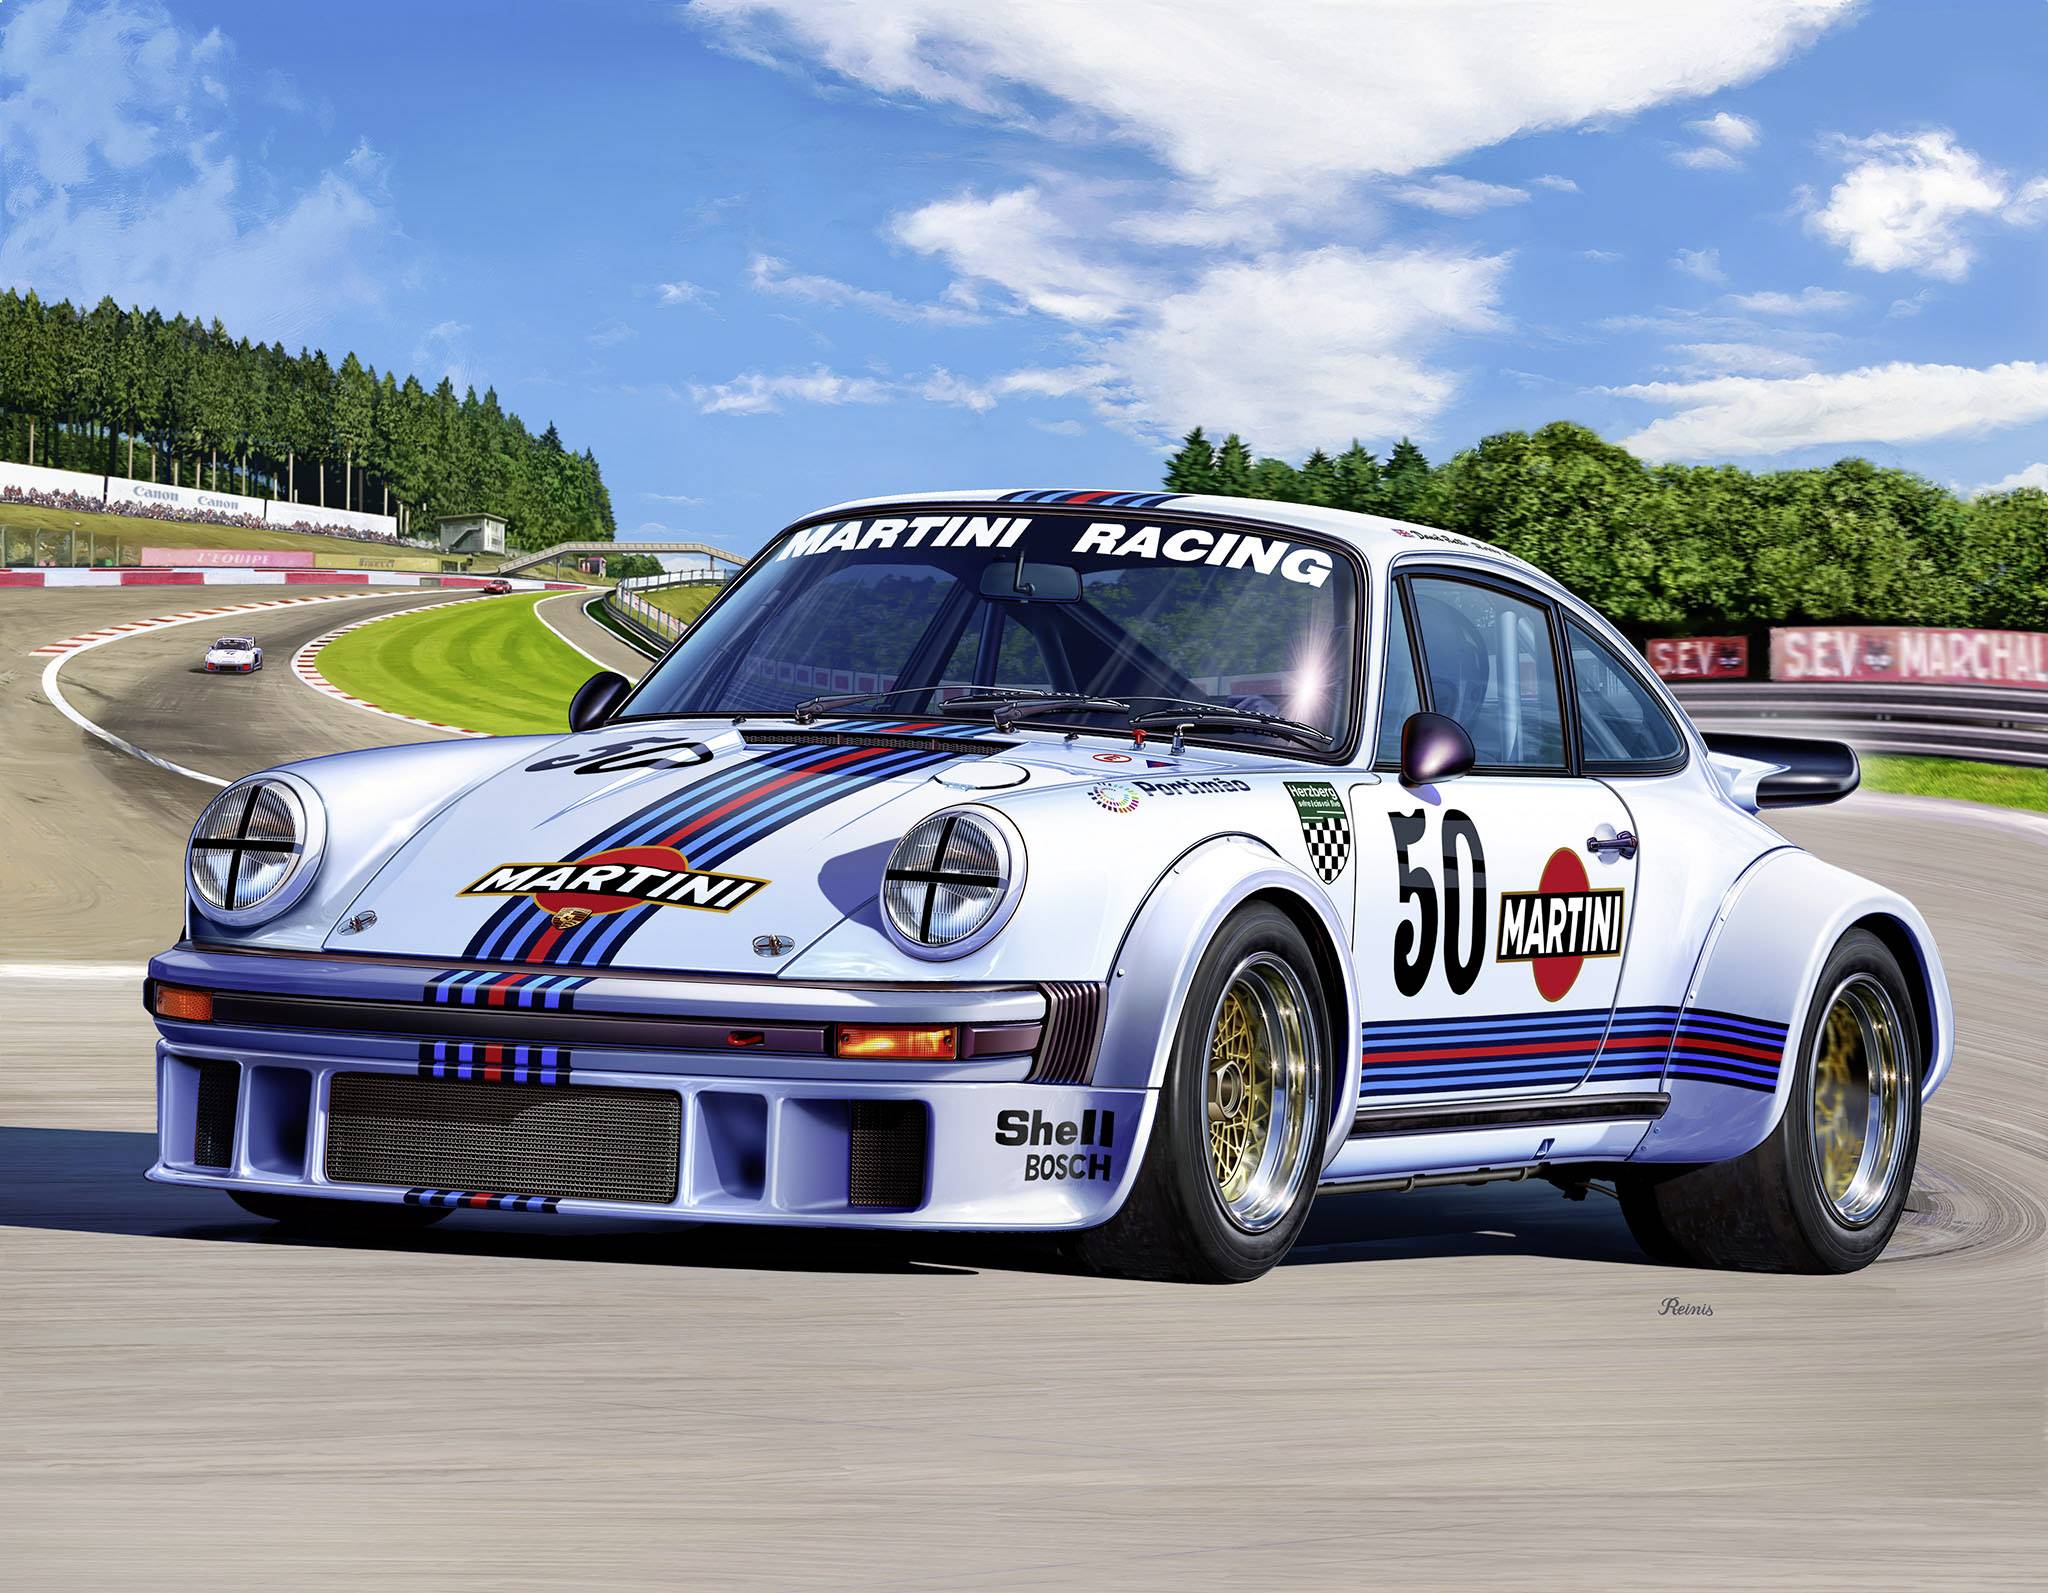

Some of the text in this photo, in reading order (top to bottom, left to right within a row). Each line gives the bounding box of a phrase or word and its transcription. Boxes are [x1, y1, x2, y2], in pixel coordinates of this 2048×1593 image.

[133, 486, 179, 501] Canon
[197, 495, 239, 510] Canon
[775, 516, 1333, 588] MARTINI RACING
[1900, 631, 2048, 682] MARCHAL
[525, 736, 714, 775] 50
[1287, 784, 1338, 800] Herzberg
[473, 864, 757, 908] MARTINI
[1387, 808, 1487, 998] 50
[1500, 895, 1621, 956] MARTINI
[995, 1109, 1114, 1148] Shell
[1024, 1153, 1111, 1182] BOSCH
[1658, 1296, 1713, 1316] Reinis
